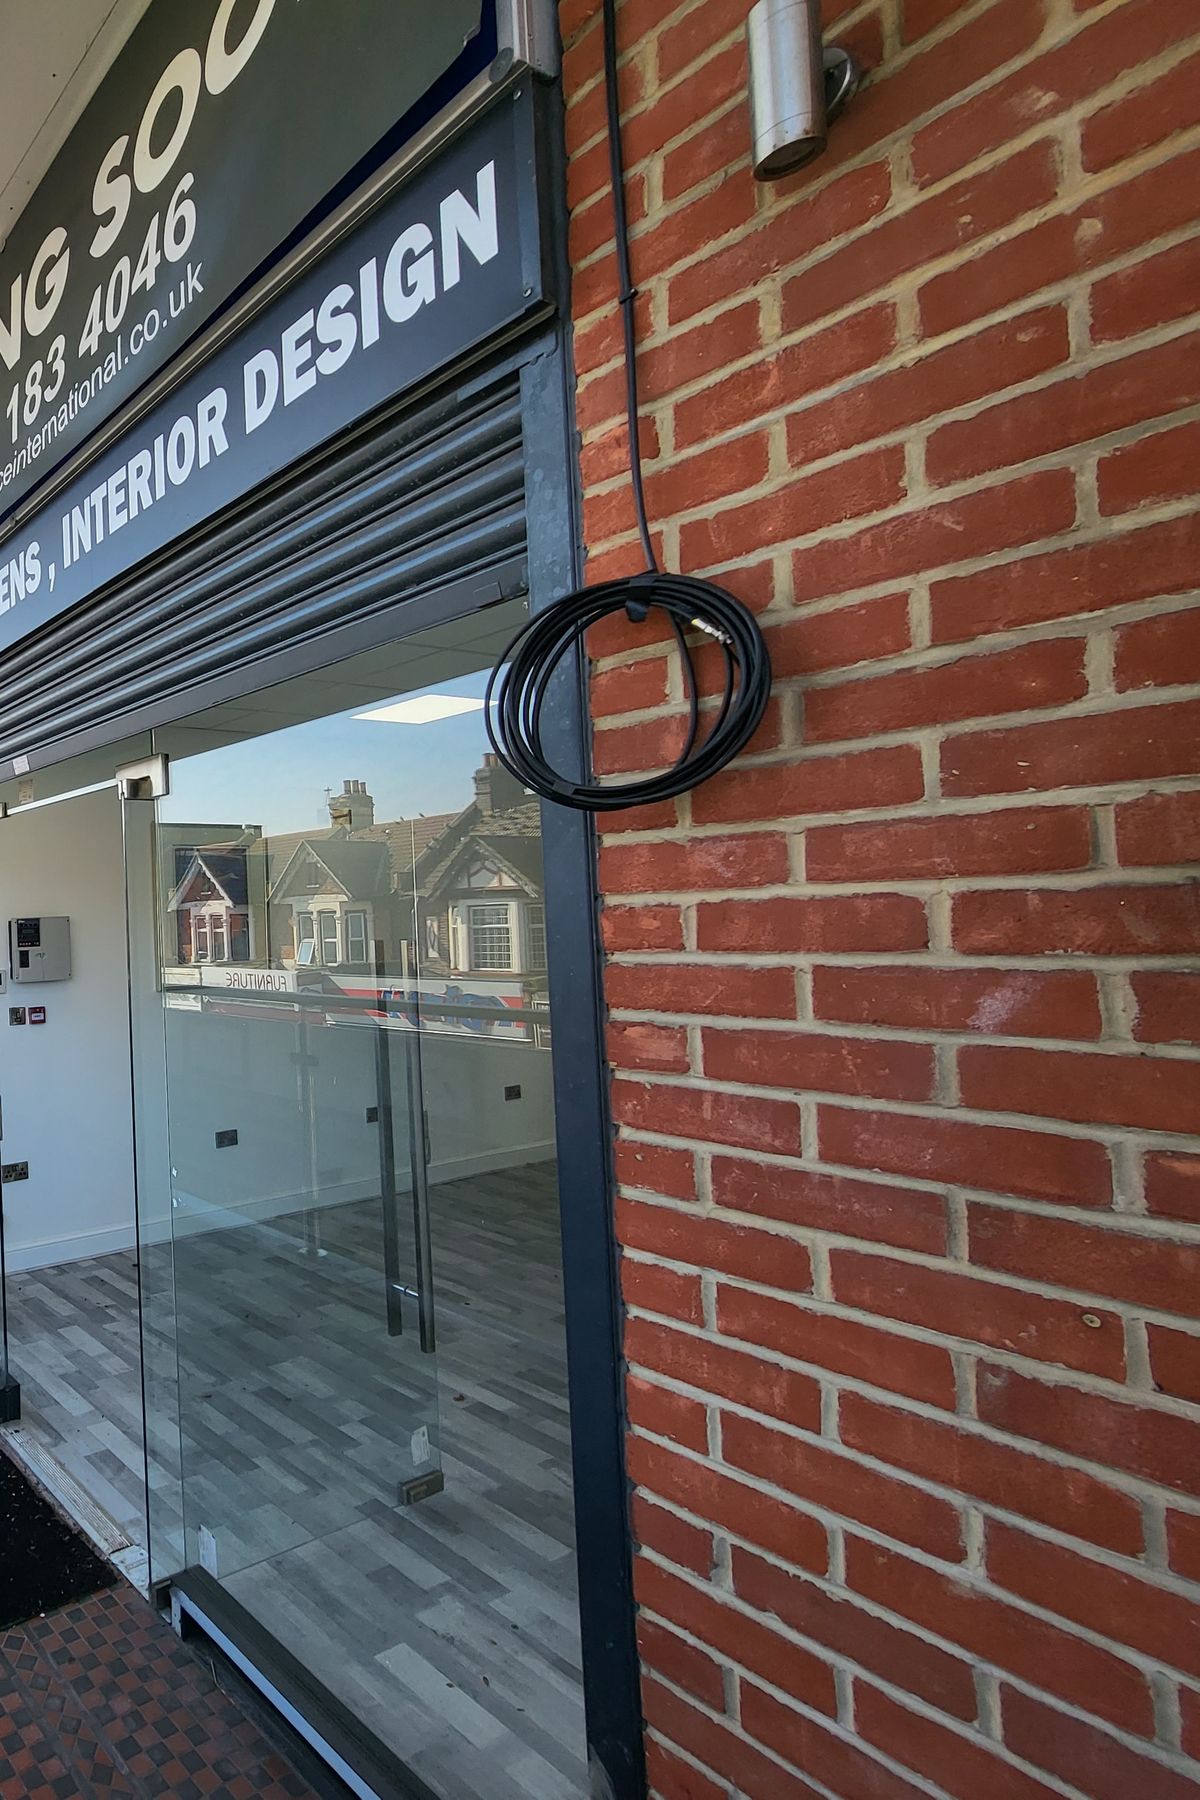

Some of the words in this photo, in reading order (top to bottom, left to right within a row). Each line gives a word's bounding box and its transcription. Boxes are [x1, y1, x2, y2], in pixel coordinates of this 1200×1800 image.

[89, 0, 280, 258] SOO
[6, 334, 66, 444] 183
[78, 172, 196, 359] 4046
[62, 386, 229, 569] INTERIOR
[242, 159, 499, 435] DESIGN
